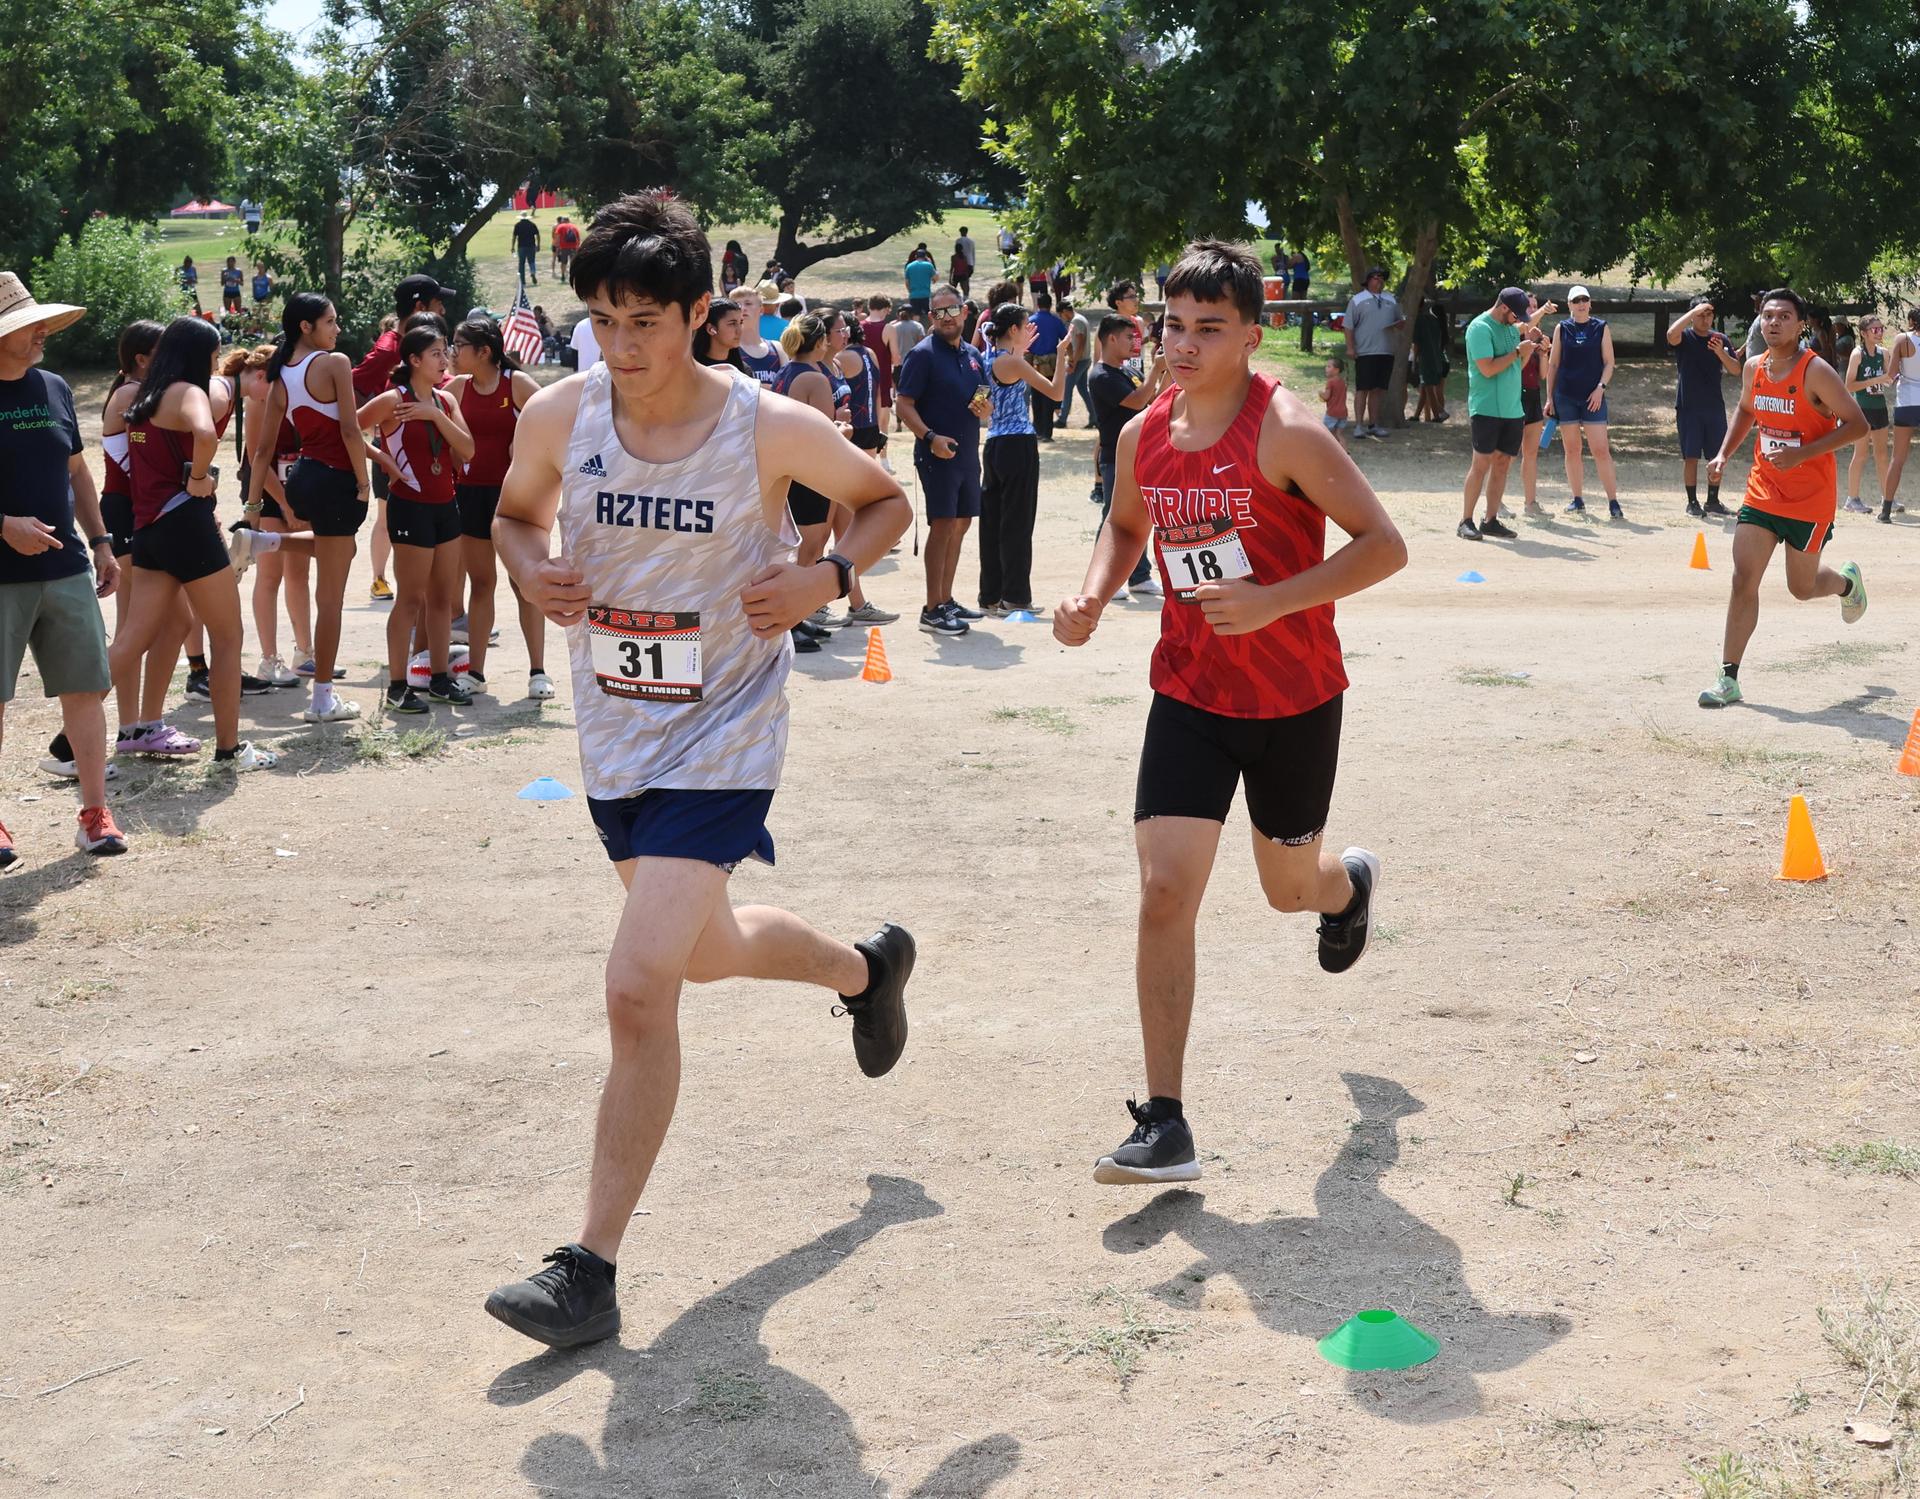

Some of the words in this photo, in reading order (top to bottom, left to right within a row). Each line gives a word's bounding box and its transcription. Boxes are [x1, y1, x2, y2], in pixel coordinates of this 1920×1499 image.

[1753, 394, 1796, 415] PORTERVILLE
[12, 419, 57, 430] education
[579, 465, 607, 478] adidas
[596, 491, 714, 534] AZTECS
[1140, 486, 1258, 529] TRIBE
[1167, 522, 1216, 541] RTS
[1181, 549, 1224, 585] 18
[608, 610, 677, 628] RTS
[618, 640, 664, 680] 31
[606, 679, 638, 692] RACE
[640, 685, 692, 696] TIMING
